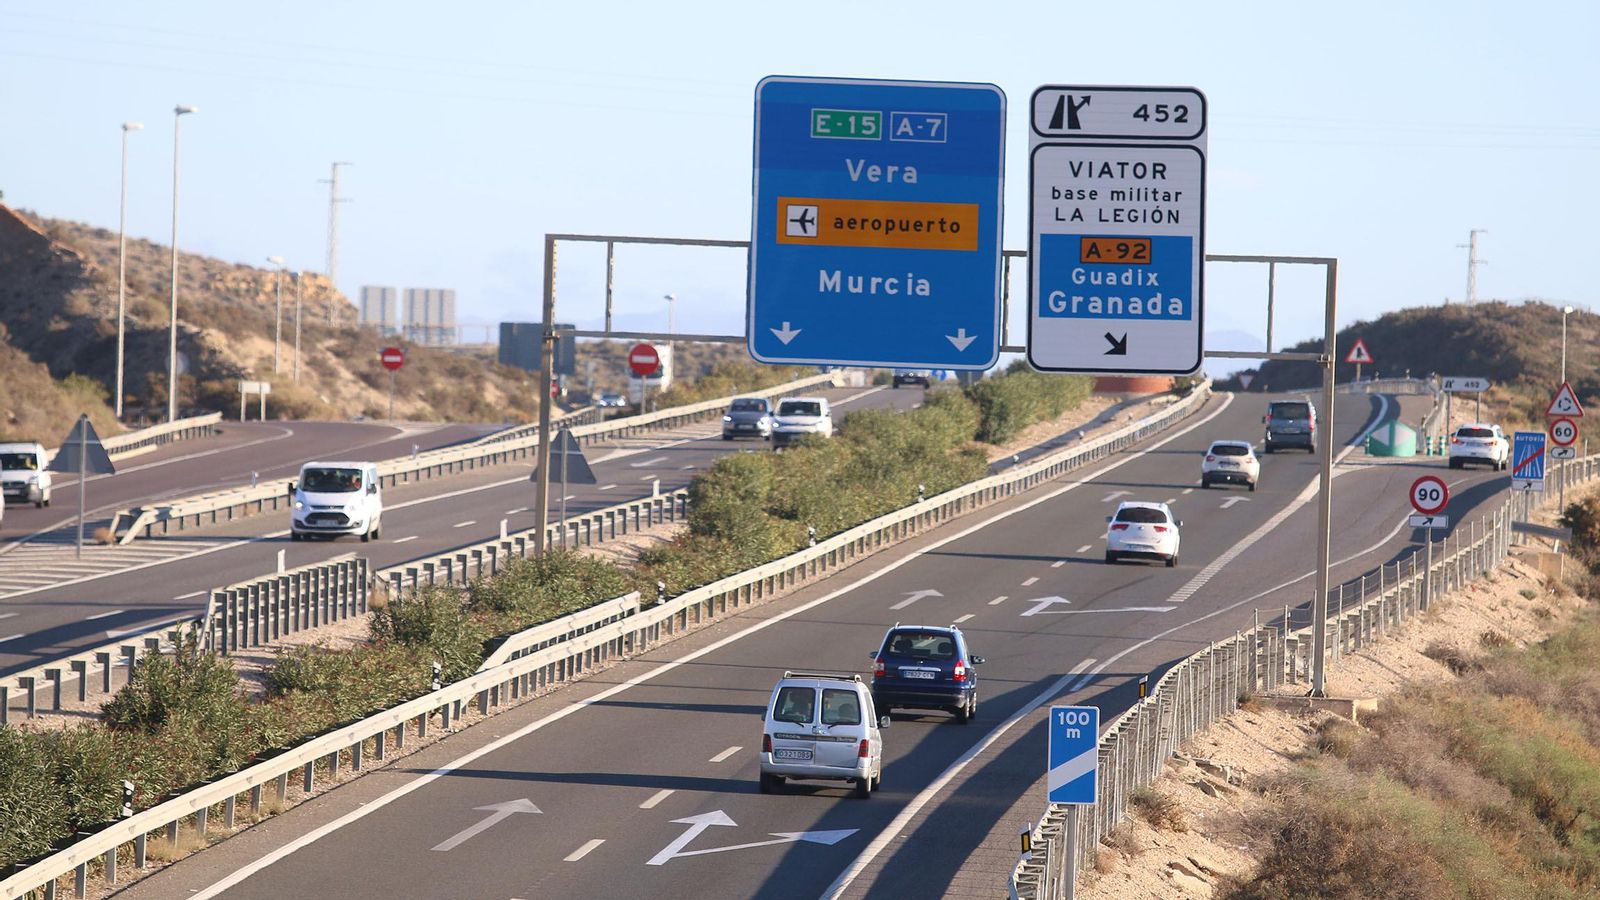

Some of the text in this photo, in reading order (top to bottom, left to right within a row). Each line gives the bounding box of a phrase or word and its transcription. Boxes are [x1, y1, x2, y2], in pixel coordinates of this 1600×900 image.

[1133, 104, 1188, 123] 452
[816, 114, 876, 135] E-15
[896, 118, 942, 137] A-7
[845, 159, 918, 184] Vera
[1069, 161, 1167, 180] VIATOR
[1052, 186, 1183, 202] base militar
[1055, 206, 1180, 224] LA LEGIÓN
[833, 216, 961, 234] aeropuerto
[1086, 242, 1147, 259] A-92
[819, 269, 931, 297] Murcia
[1072, 267, 1160, 286] Guadix
[1048, 290, 1183, 316] Granada
[1555, 427, 1572, 437] 60
[1418, 488, 1440, 501] 90
[1058, 711, 1090, 726] 100
[1066, 728, 1081, 739] m
